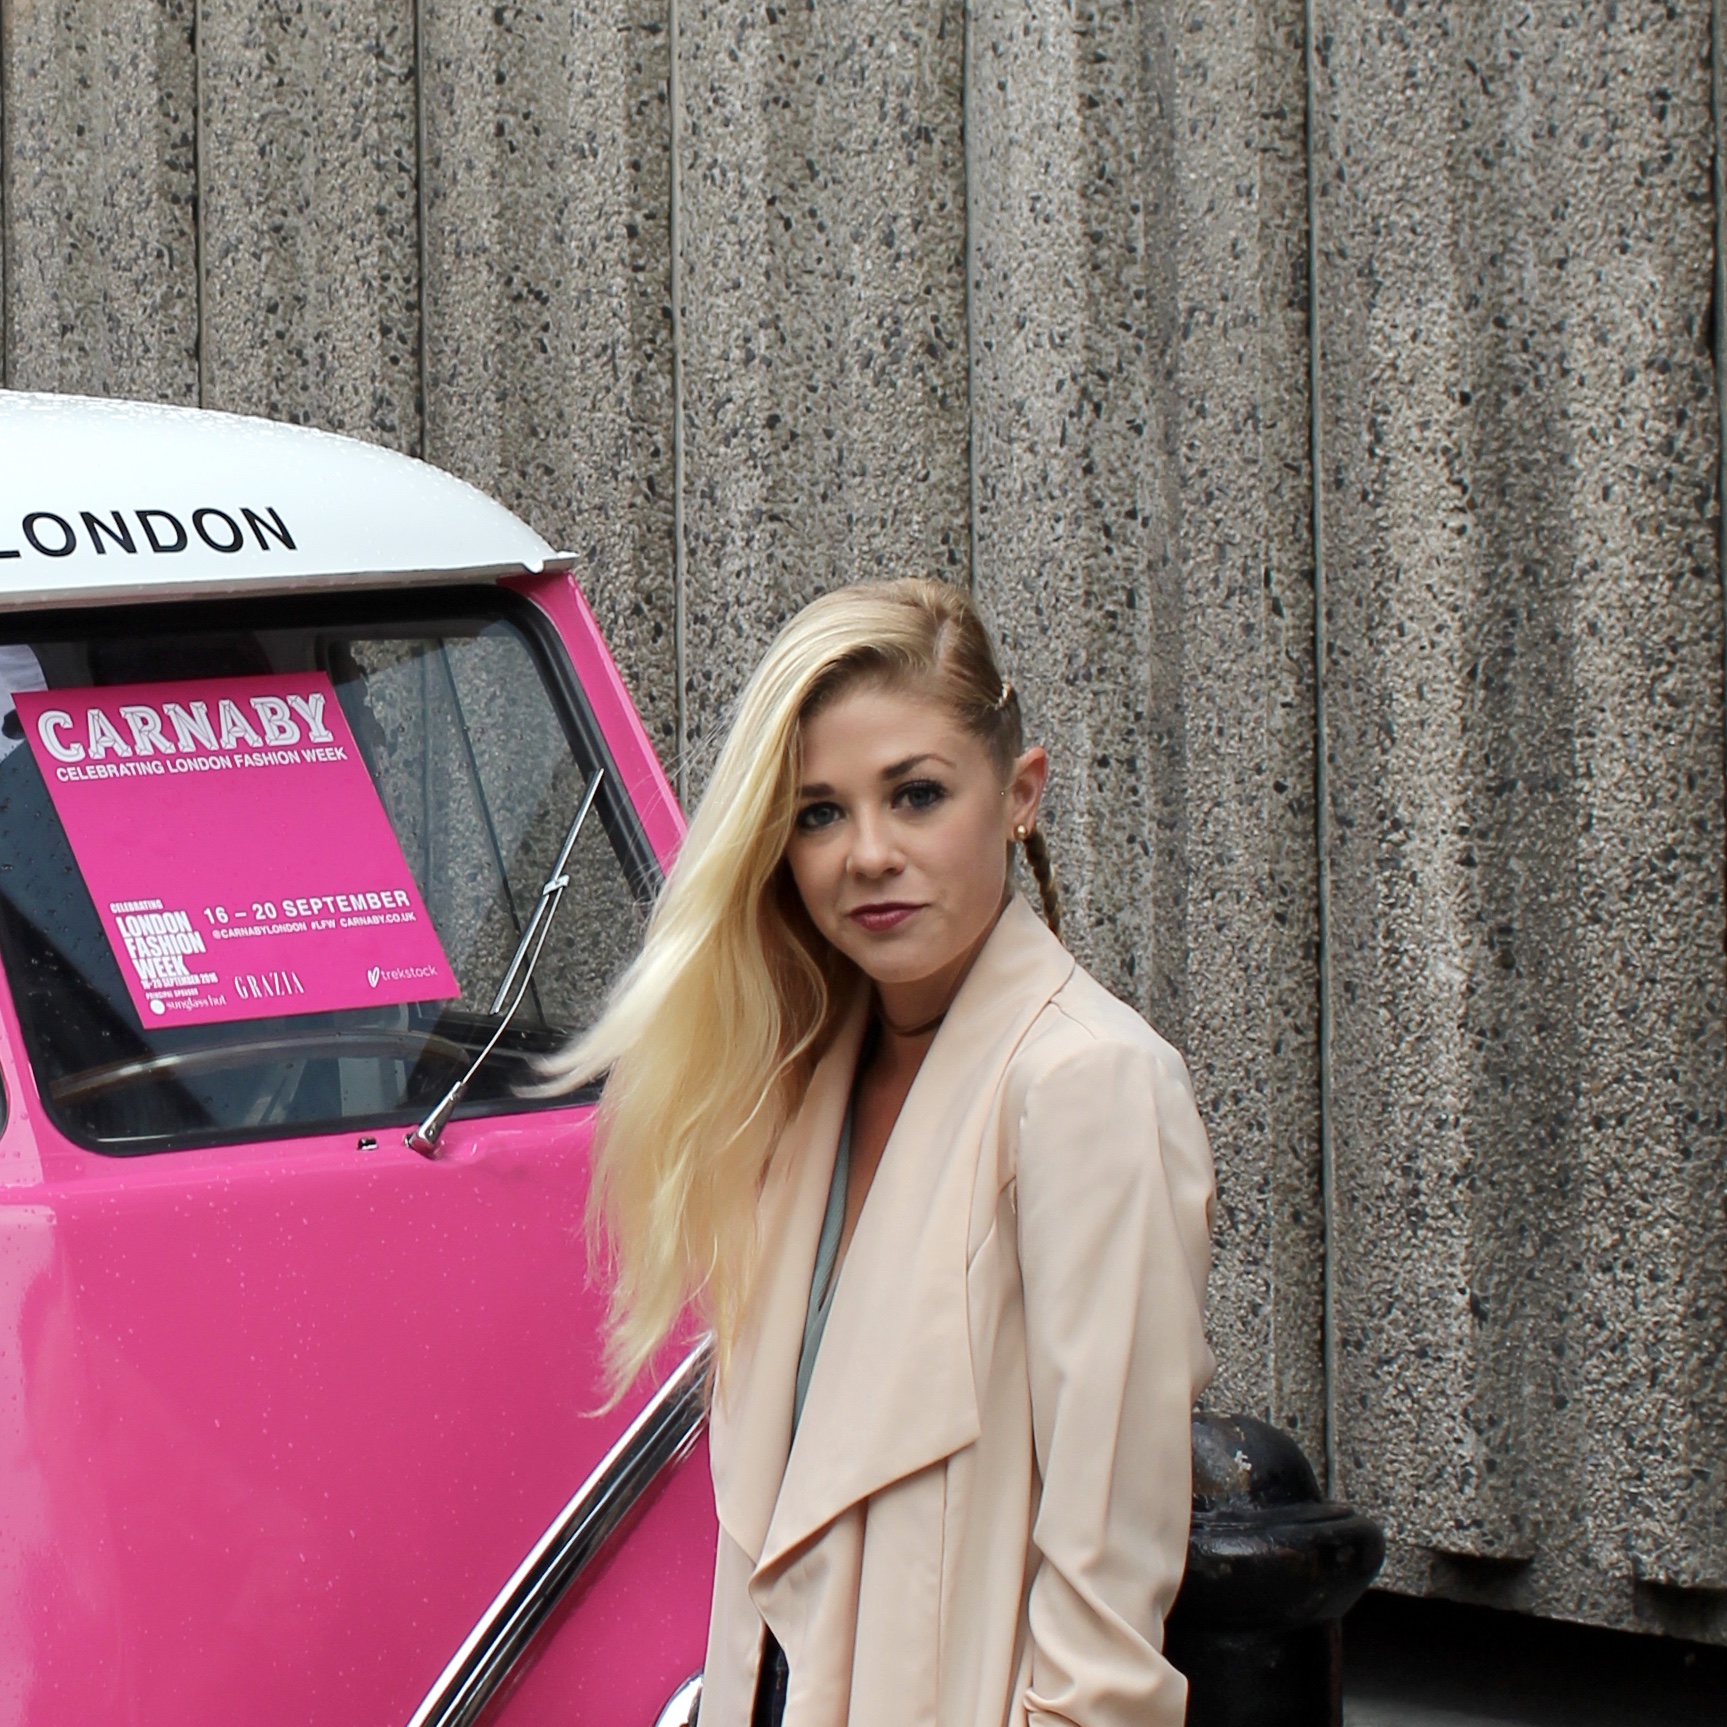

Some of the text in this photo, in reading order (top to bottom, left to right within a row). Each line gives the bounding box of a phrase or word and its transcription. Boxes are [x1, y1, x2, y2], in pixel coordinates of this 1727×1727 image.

[37, 692, 334, 763] CARNABY
[56, 746, 348, 783] CELEBRATING LONDON FASHION WEEK
[109, 899, 163, 914] CELEBRATING
[203, 906, 229, 925] 16
[252, 902, 278, 920] 20
[282, 889, 411, 918] SEPTEMBER
[115, 910, 192, 938] LONDON
[212, 911, 416, 940] @CARNABYLONDON #LFW CARNABY.CO.UK
[124, 930, 207, 959] FASHION
[132, 955, 191, 981] WEEK
[380, 964, 438, 981] trekstock
[234, 971, 304, 1000] GRAZIA
[208, 994, 227, 1008] hut
